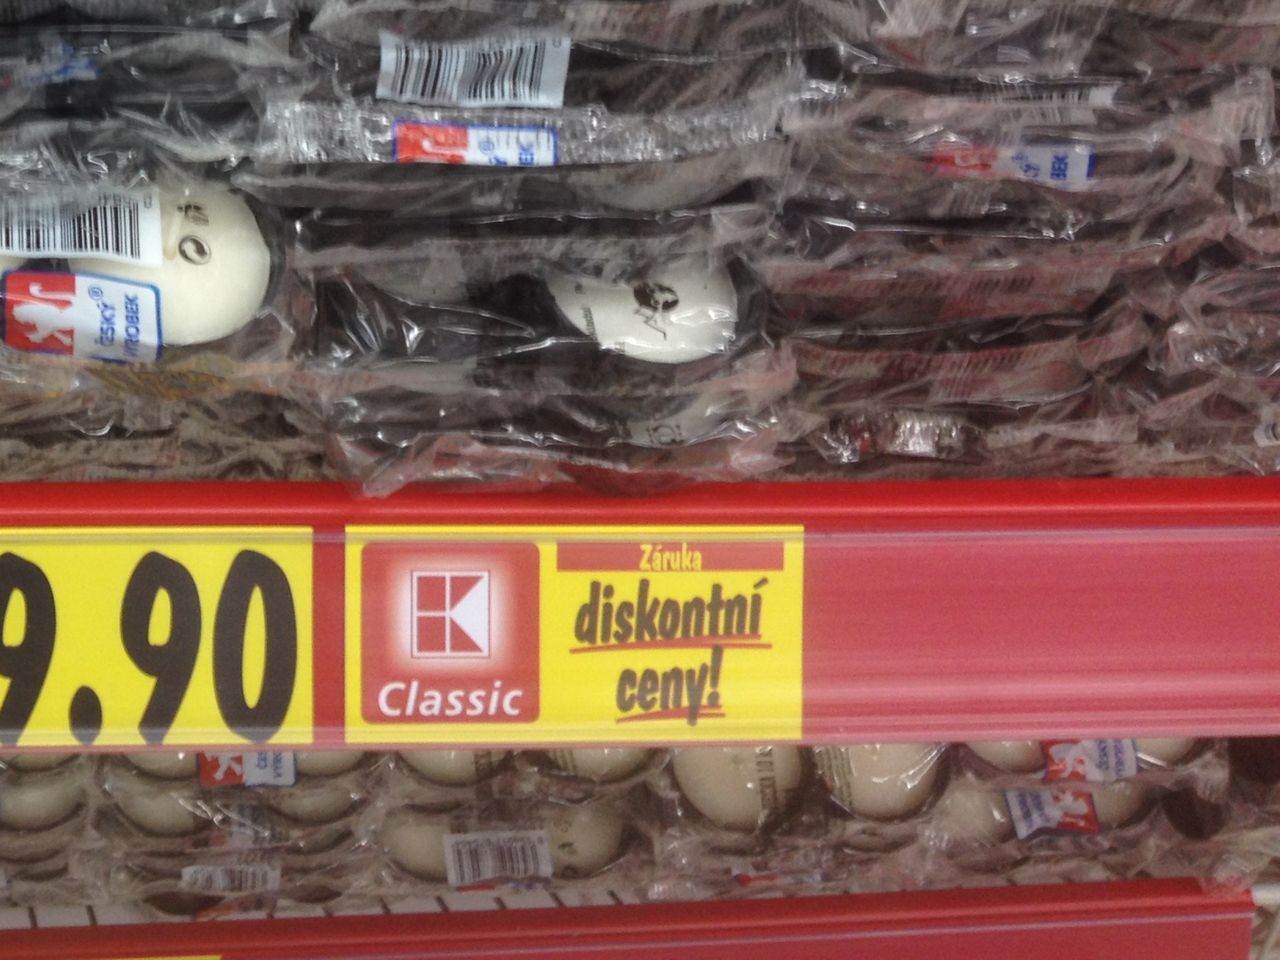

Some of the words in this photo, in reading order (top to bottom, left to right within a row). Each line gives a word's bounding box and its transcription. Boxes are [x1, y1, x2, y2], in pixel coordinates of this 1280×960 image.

[639, 543, 703, 572] Záruka
[574, 576, 769, 644] diskontní
[377, 680, 524, 717] Classic
[615, 644, 724, 727] ceny!
